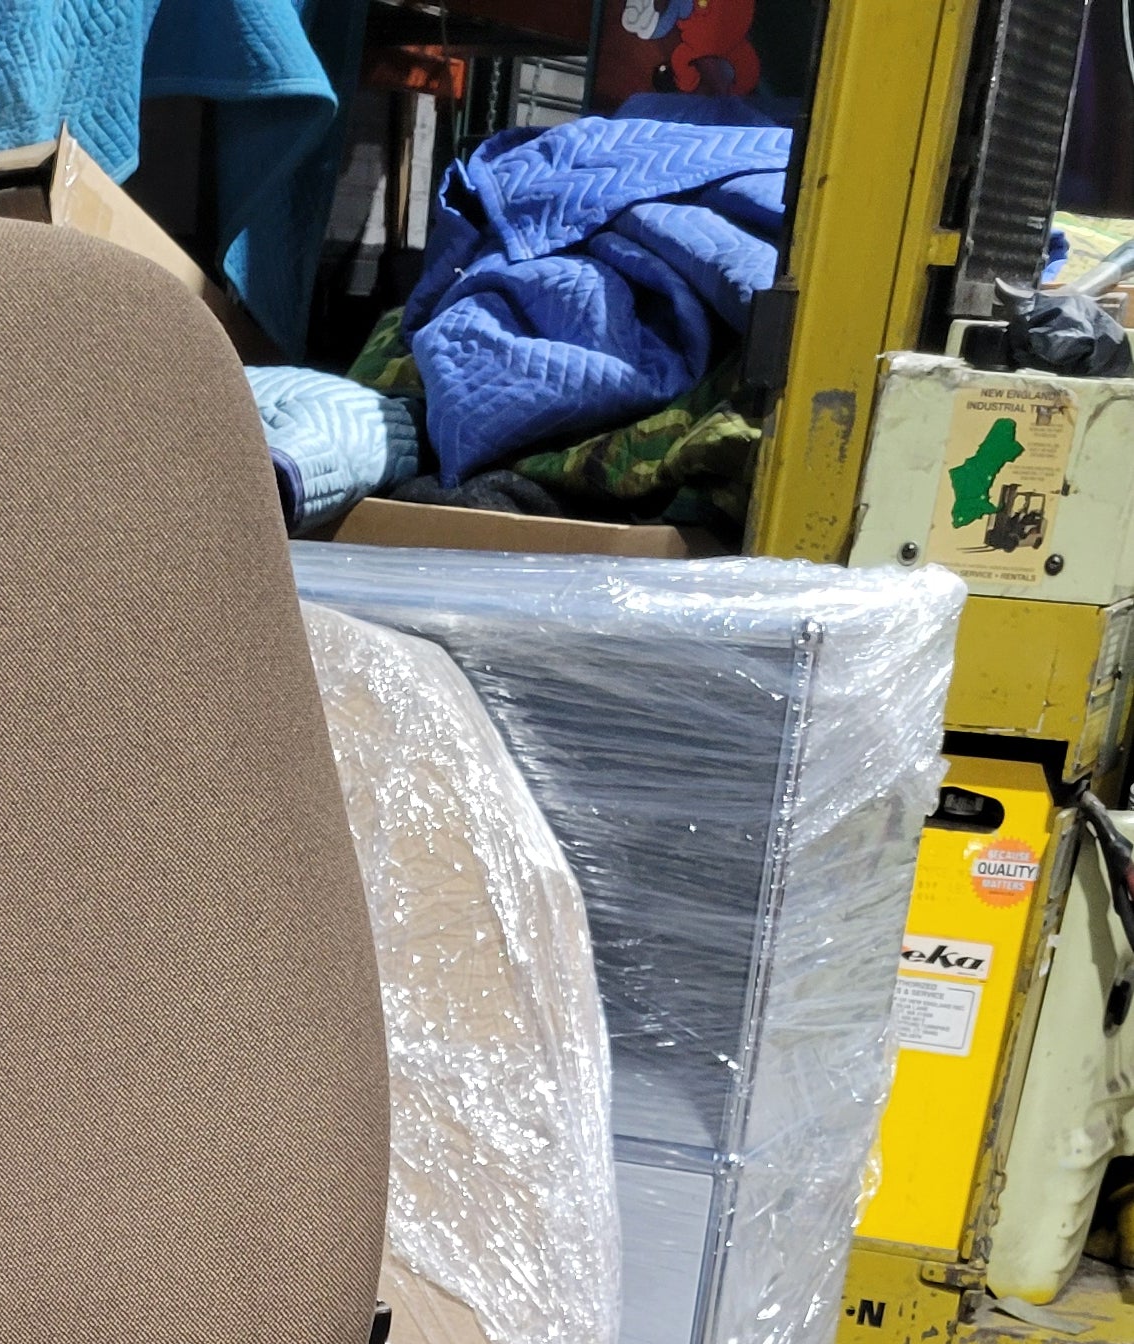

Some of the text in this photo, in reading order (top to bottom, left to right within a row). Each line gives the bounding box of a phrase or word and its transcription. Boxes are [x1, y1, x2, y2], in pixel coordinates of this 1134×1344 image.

[980, 388, 1059, 401] NEW ENGLAND
[966, 401, 1026, 413] INDUSTRIAL
[1000, 572, 1036, 582] RENTALS
[977, 861, 1037, 879] QUALITY
[982, 879, 1026, 892] MATTERS
[901, 944, 986, 970] eka
